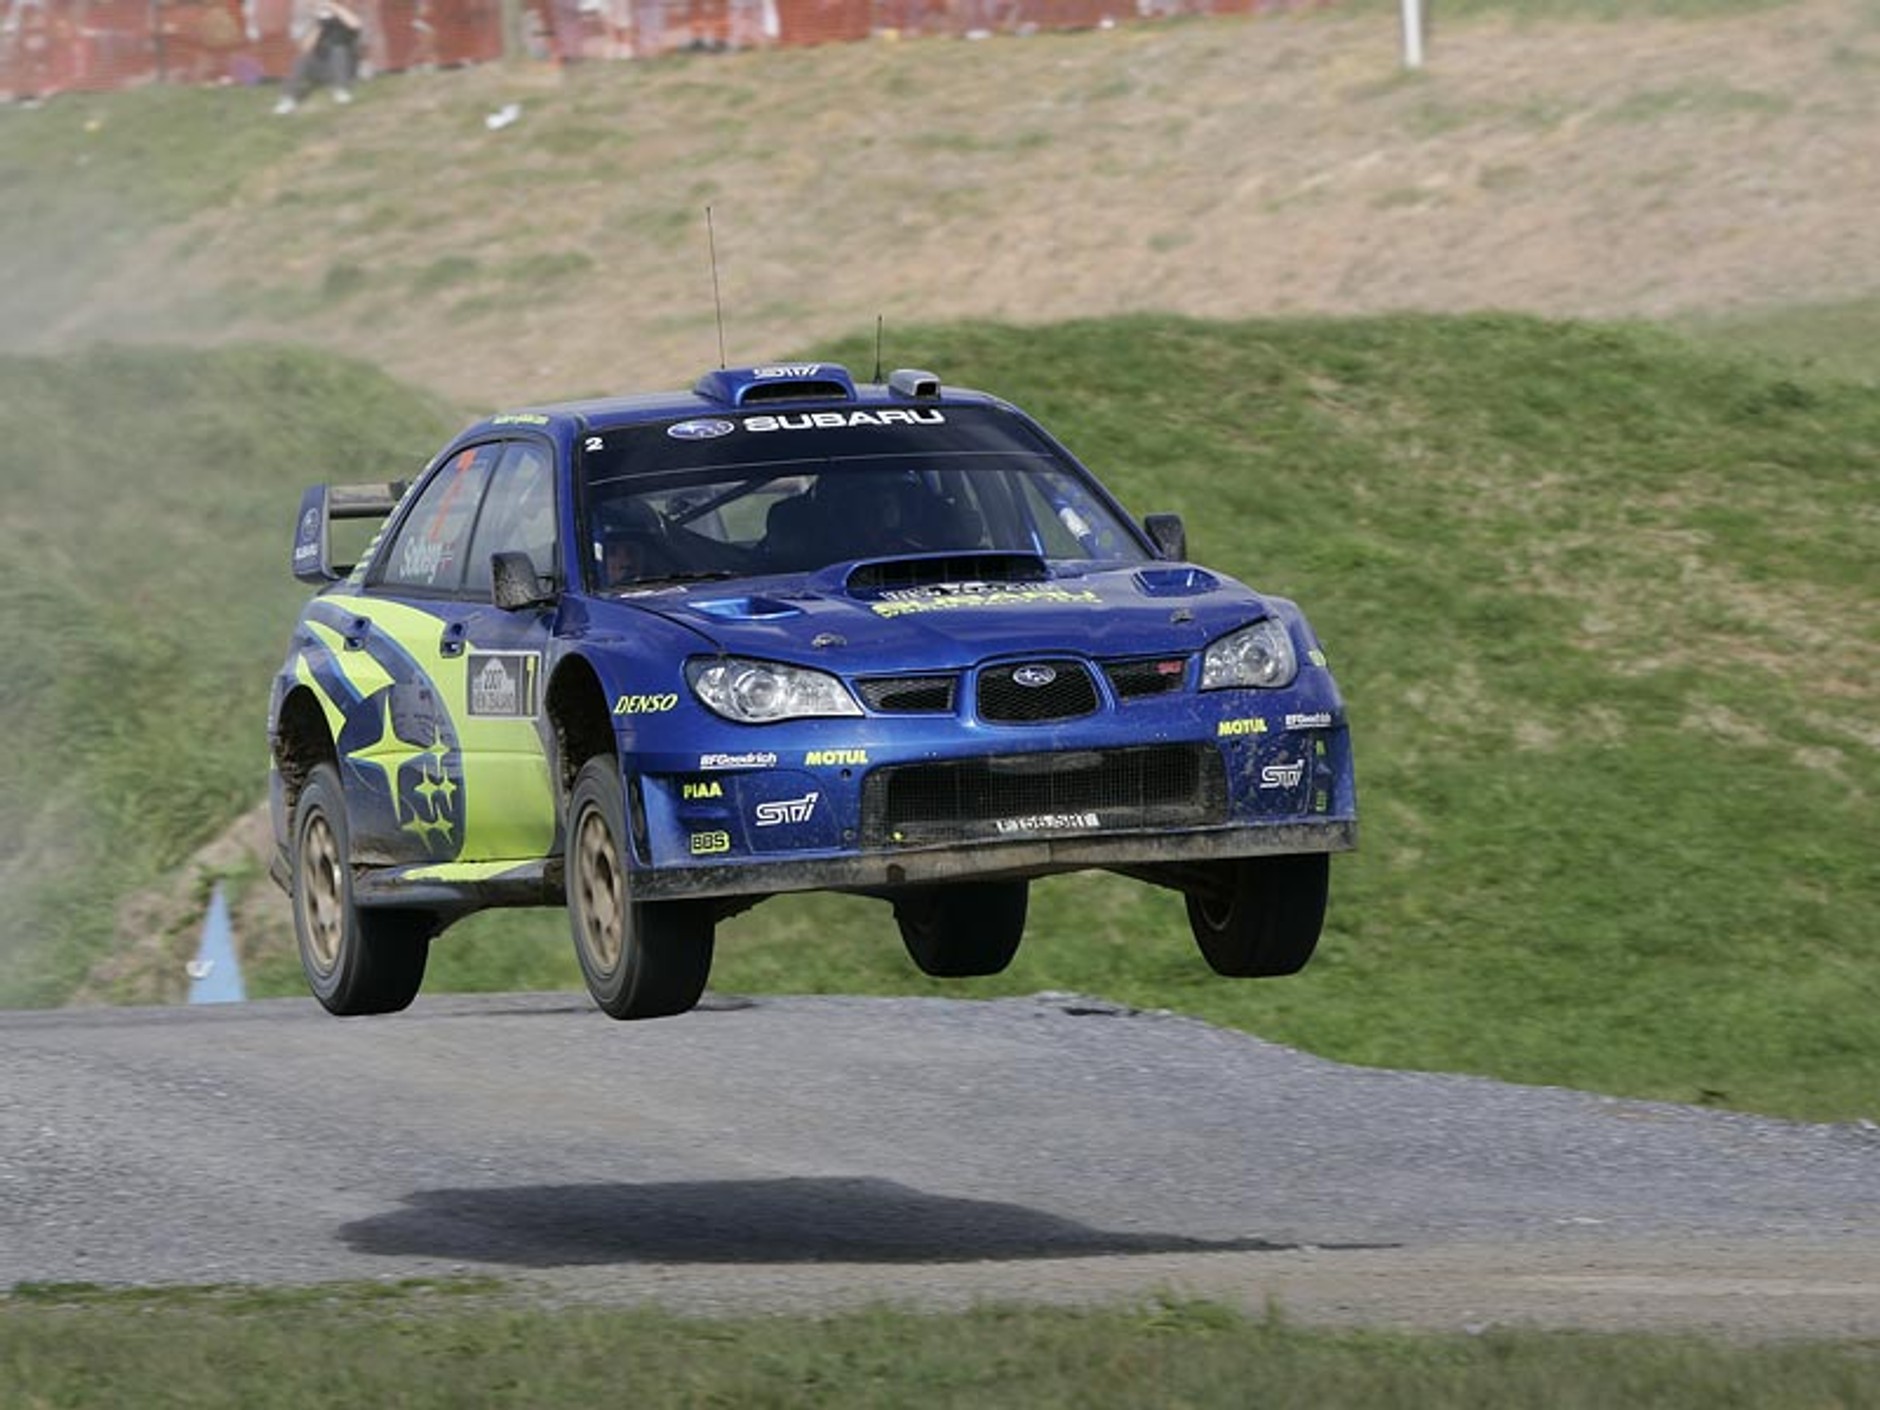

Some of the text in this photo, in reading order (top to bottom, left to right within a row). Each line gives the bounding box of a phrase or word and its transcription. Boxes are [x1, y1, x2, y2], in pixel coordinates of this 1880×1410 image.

[742, 408, 946, 433] SUBARU
[584, 437, 604, 452] 2
[613, 693, 679, 715] DENSO
[1217, 717, 1268, 737] MOTUL
[804, 749, 869, 766] MOTUL
[683, 781, 723, 799] PIAA
